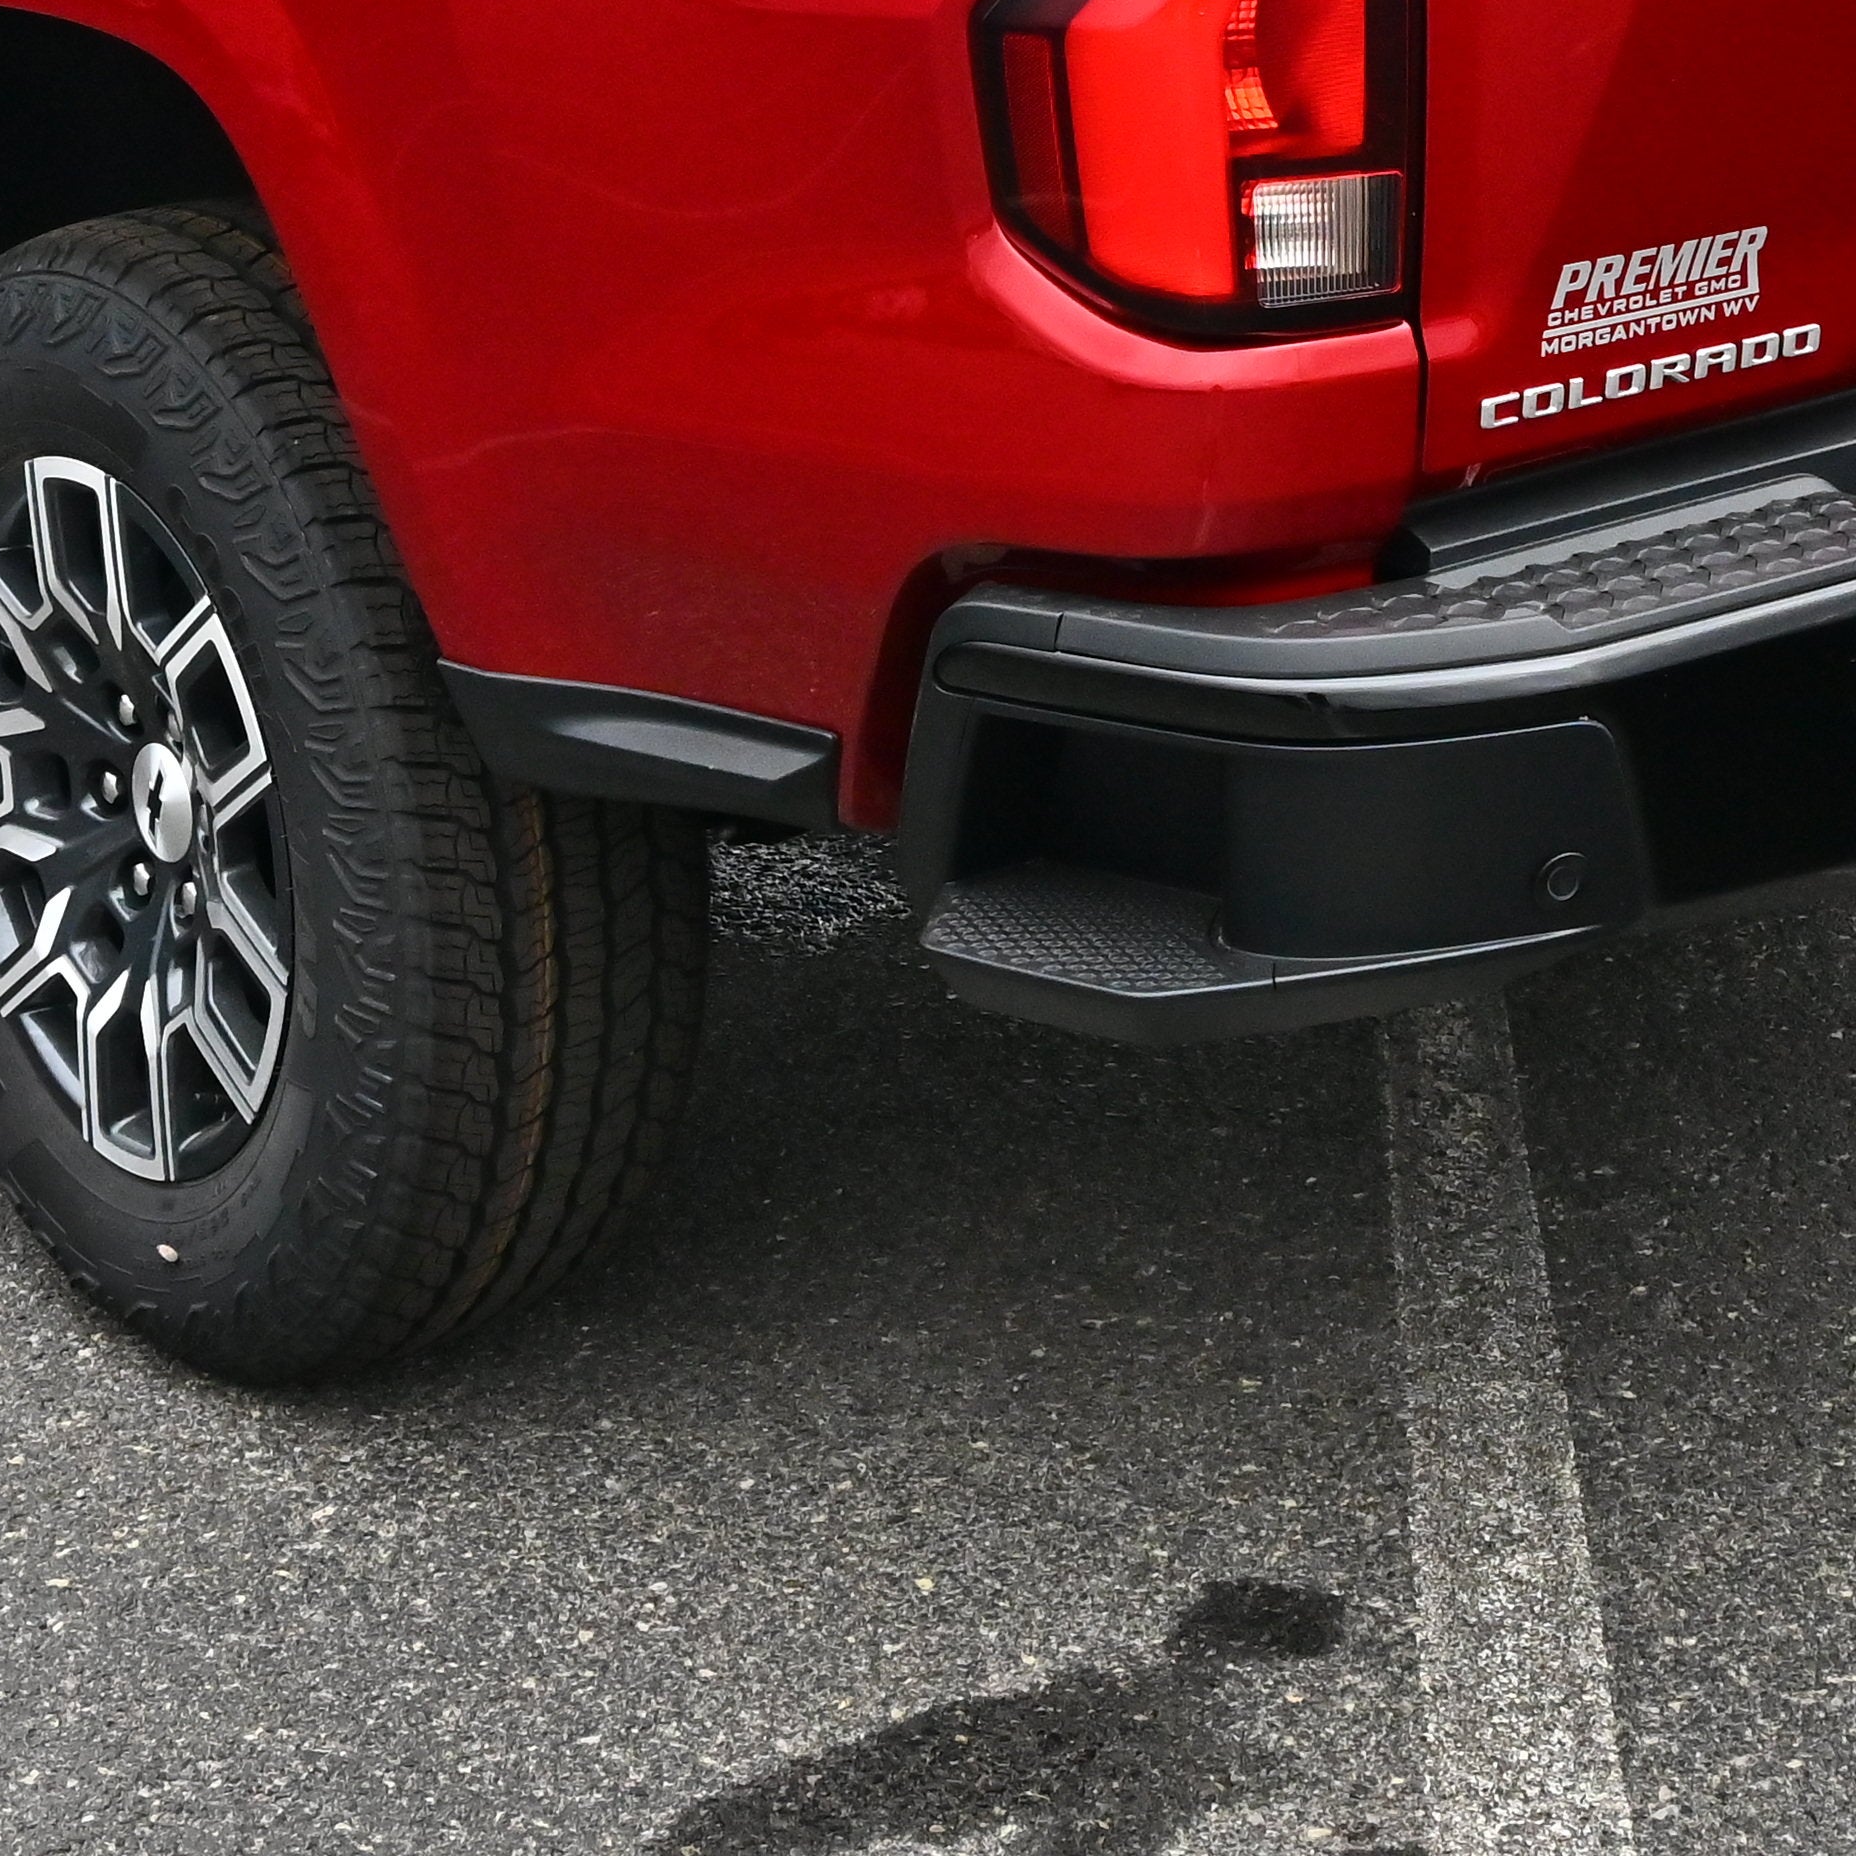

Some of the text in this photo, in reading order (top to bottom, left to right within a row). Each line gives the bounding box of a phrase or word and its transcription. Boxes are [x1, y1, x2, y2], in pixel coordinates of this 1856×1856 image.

[1547, 273, 1743, 328] CHEVROLET GMC
[1549, 226, 1769, 311] PREMIER
[1540, 295, 1760, 358] MORGANTOWN WV
[1479, 323, 1822, 430] COLORADO
